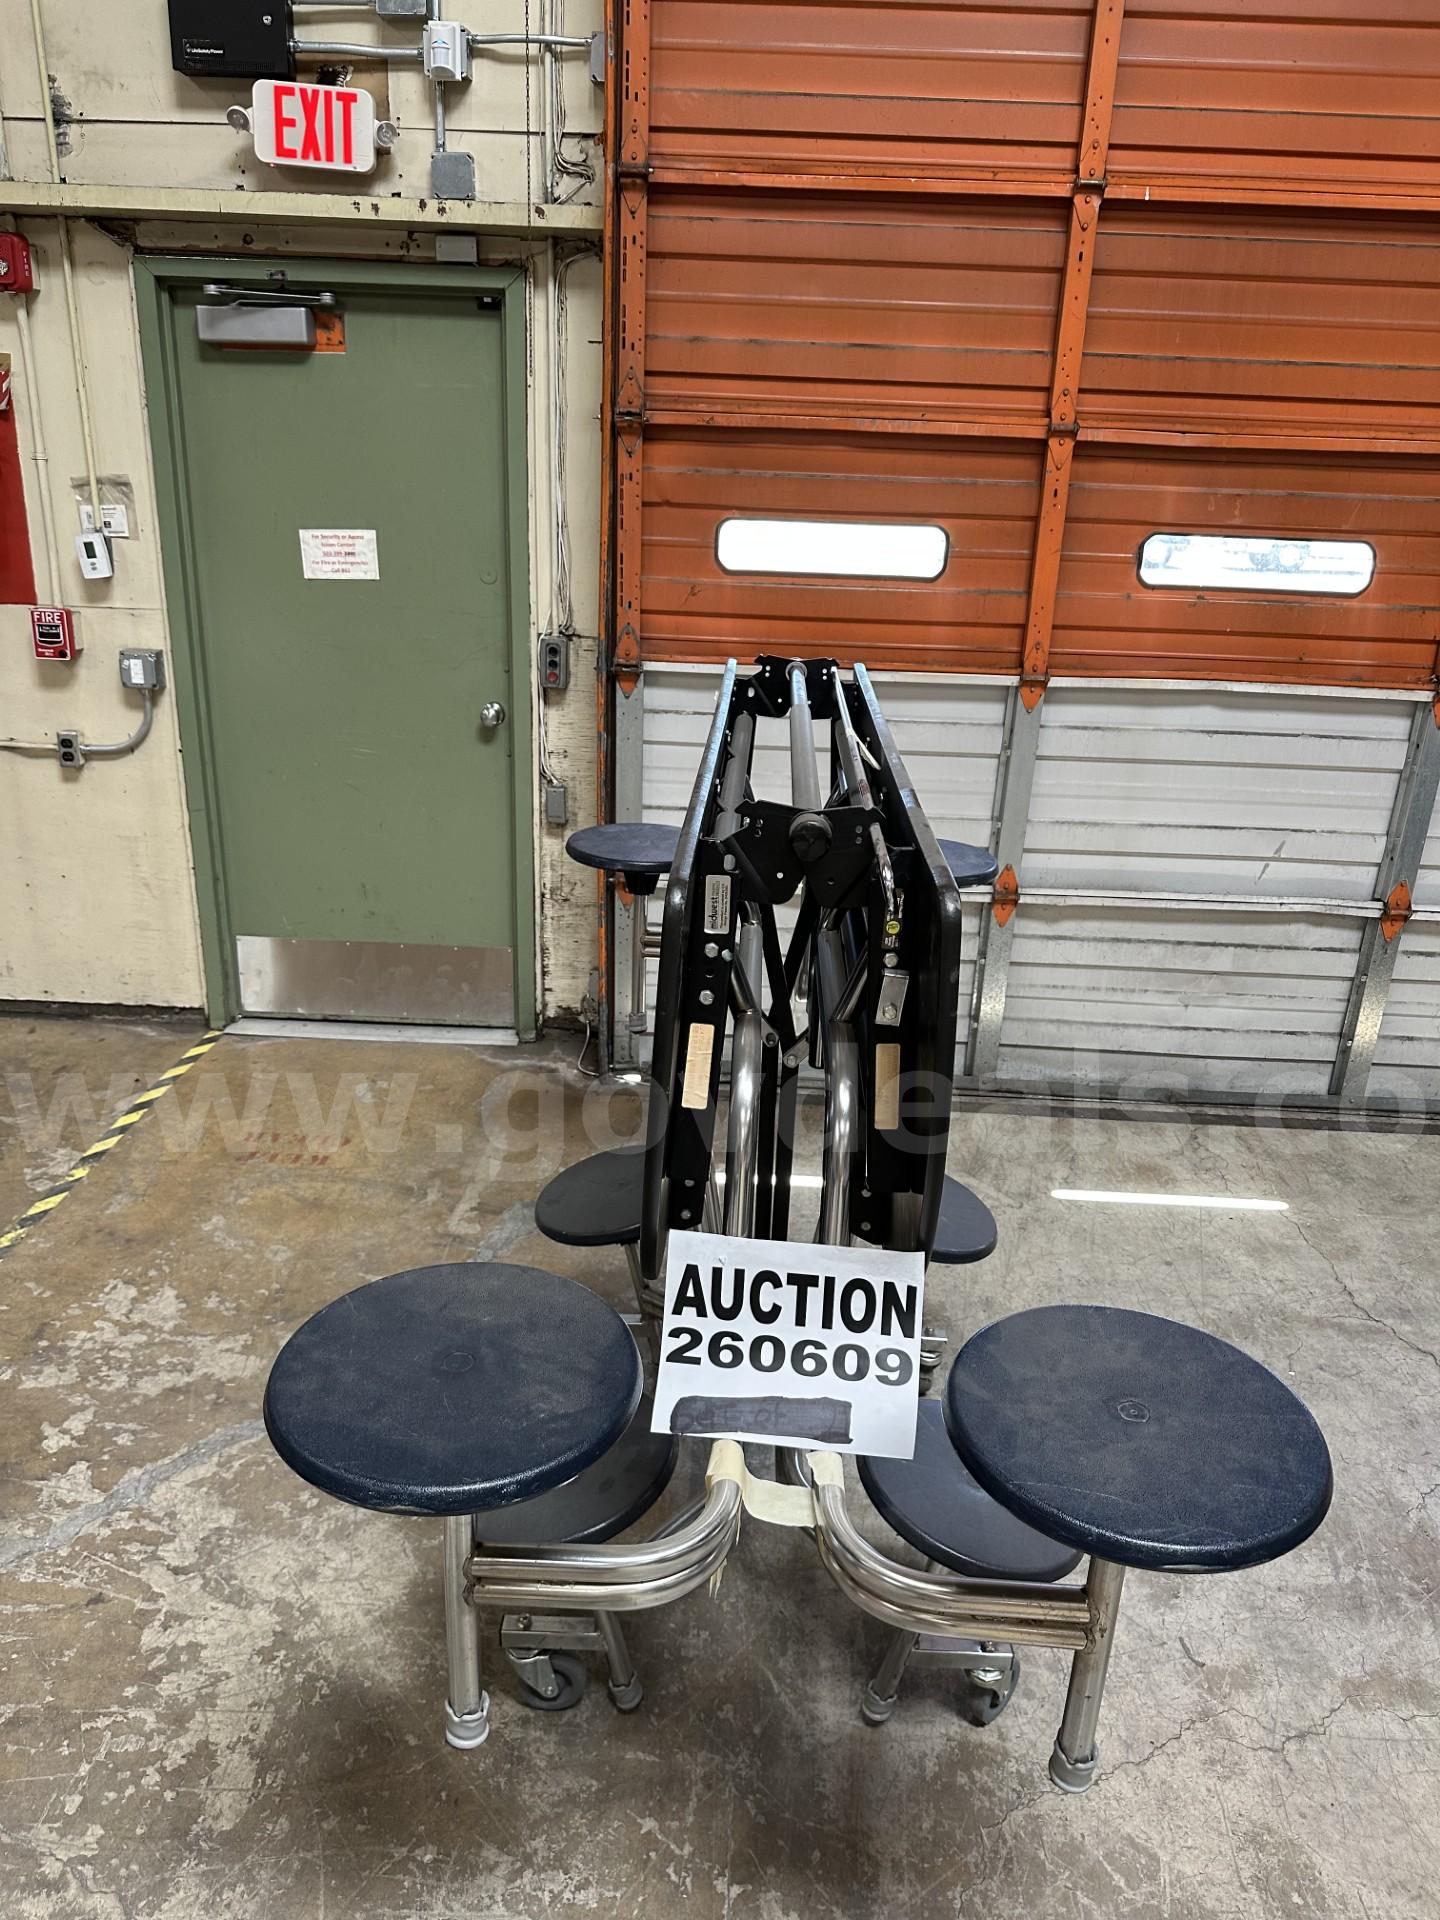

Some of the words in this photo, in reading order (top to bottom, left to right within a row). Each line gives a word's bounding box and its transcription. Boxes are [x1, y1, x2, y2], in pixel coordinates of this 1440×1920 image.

[273, 85, 358, 165] EXIT
[33, 611, 62, 623] FIRE
[671, 1263, 918, 1339] AUCTION
[665, 1326, 914, 1387] 260609
